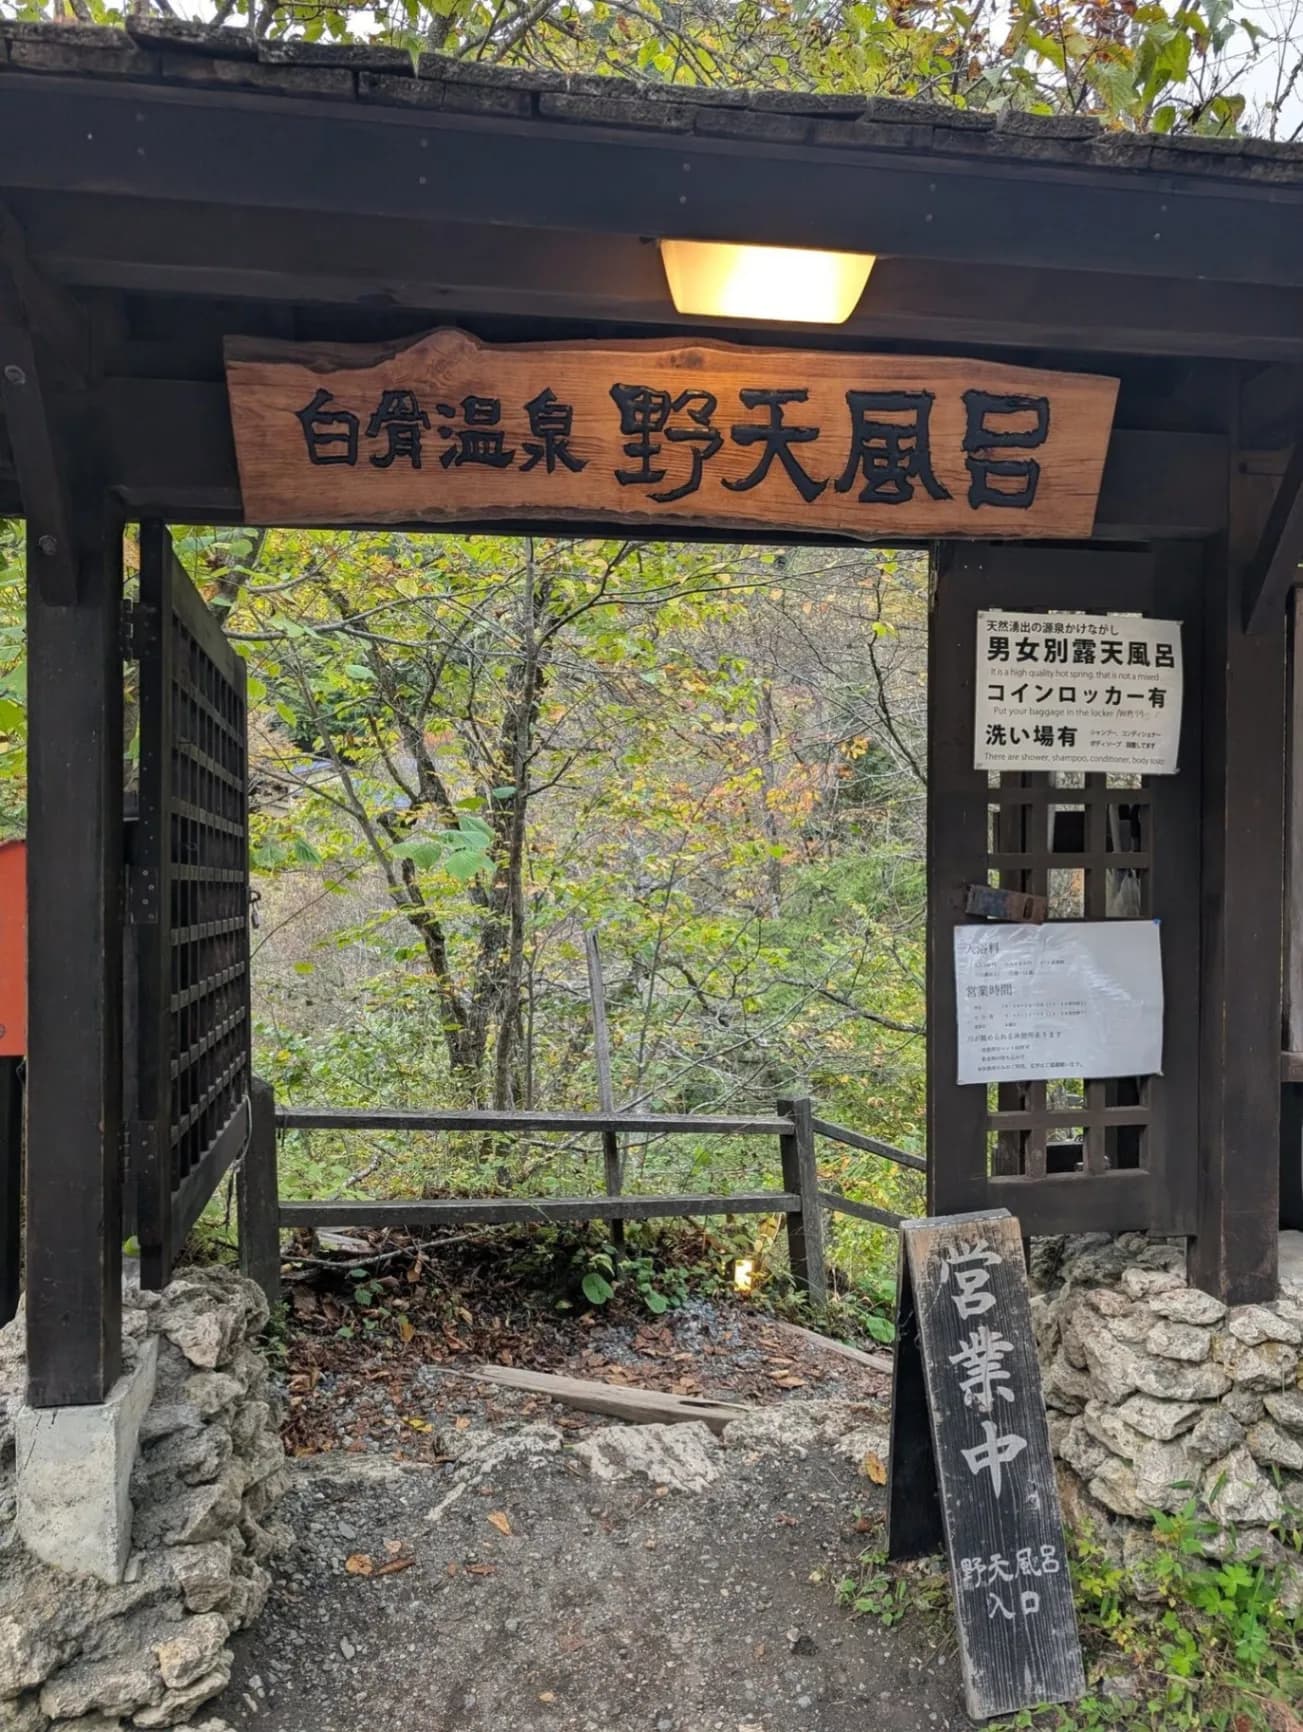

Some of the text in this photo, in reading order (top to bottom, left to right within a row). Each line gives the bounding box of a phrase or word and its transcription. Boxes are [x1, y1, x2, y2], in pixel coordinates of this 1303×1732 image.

[295, 382, 1052, 509] 白骨温泉 野天風呂
[986, 620, 1119, 636] 天然湧出の源泉かけながし
[987, 636, 1175, 669] 男女別露天風呂
[1010, 667, 1027, 678] high
[1028, 668, 1054, 679] quality
[1056, 669, 1069, 678] hot
[987, 683, 1167, 709] コインロッカー有
[993, 706, 1007, 716] Put
[1009, 708, 1027, 718] your
[1029, 707, 1065, 718] baggage
[1075, 708, 1090, 717] the
[1091, 709, 1114, 718] locker
[985, 724, 1078, 748] 洗い場有
[985, 752, 1006, 761] There
[966, 983, 1013, 999] 営業時間
[940, 1239, 1028, 1499] 営業中
[961, 1545, 1060, 1588] 野天風呂
[988, 1592, 1040, 1619] 入口
